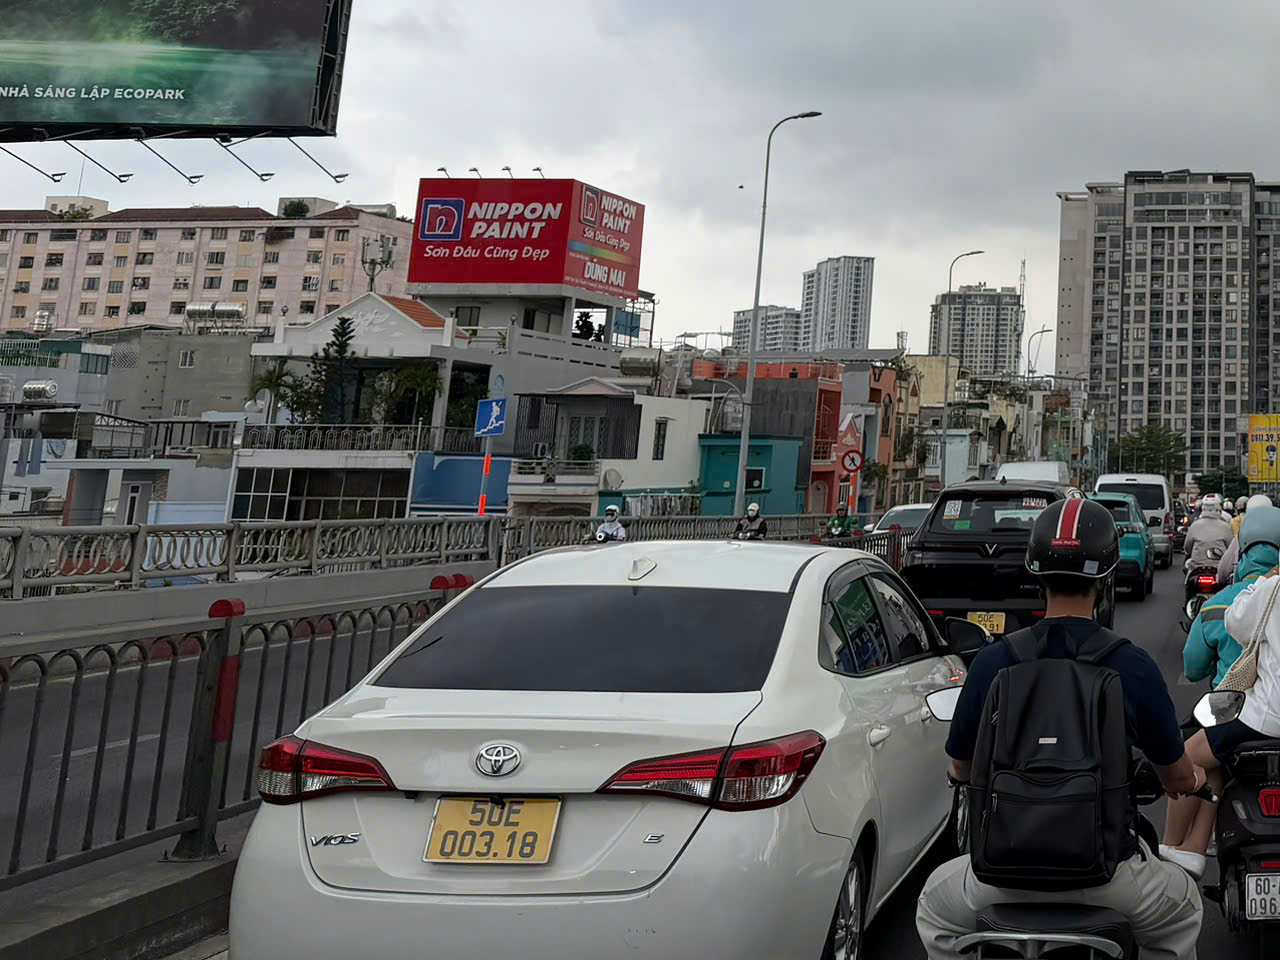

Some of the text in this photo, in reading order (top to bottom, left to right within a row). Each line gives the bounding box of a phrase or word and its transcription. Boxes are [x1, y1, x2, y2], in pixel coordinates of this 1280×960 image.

[0, 84, 185, 101] NHÀ SÁNG LẬP ECOPARK
[467, 202, 563, 219] NIPPON
[601, 195, 637, 220] NIPPON
[470, 221, 546, 239] PAINT
[602, 212, 631, 234] PAINT
[423, 245, 550, 261] Sơn Đâu Cũng Đẹp
[609, 268, 626, 288] MAI
[468, 800, 525, 827] 50E
[311, 832, 362, 847] VIOS
[439, 830, 539, 858] 003.18
[643, 832, 665, 844] E
